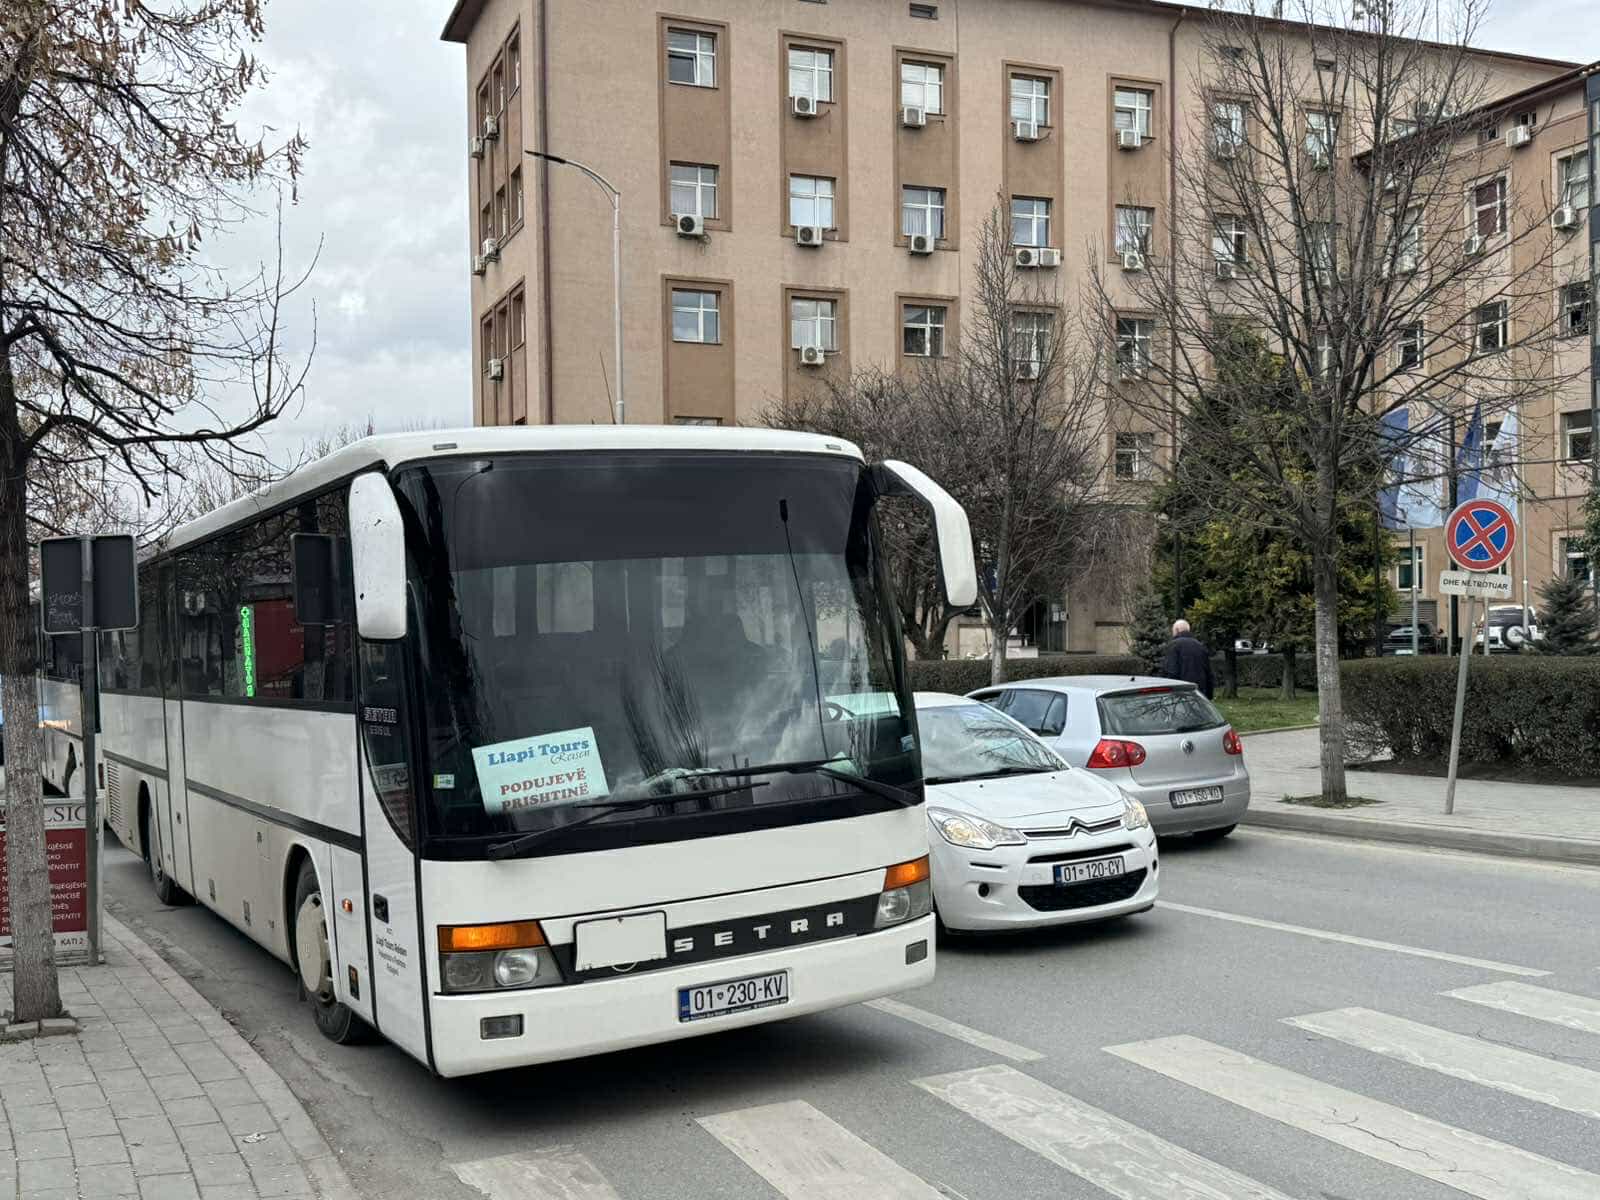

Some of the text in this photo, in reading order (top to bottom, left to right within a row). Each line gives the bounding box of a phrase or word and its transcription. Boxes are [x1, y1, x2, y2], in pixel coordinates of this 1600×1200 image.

[1443, 578, 1460, 586] DHE
[487, 739, 590, 766] Llapi Tours
[500, 767, 587, 796] PODUJEVË
[501, 783, 590, 812] PRISHTINË
[1063, 866, 1077, 882] 01
[674, 912, 844, 953] SETRA
[694, 988, 713, 1011] 01
[727, 975, 783, 1006] 230-KV
